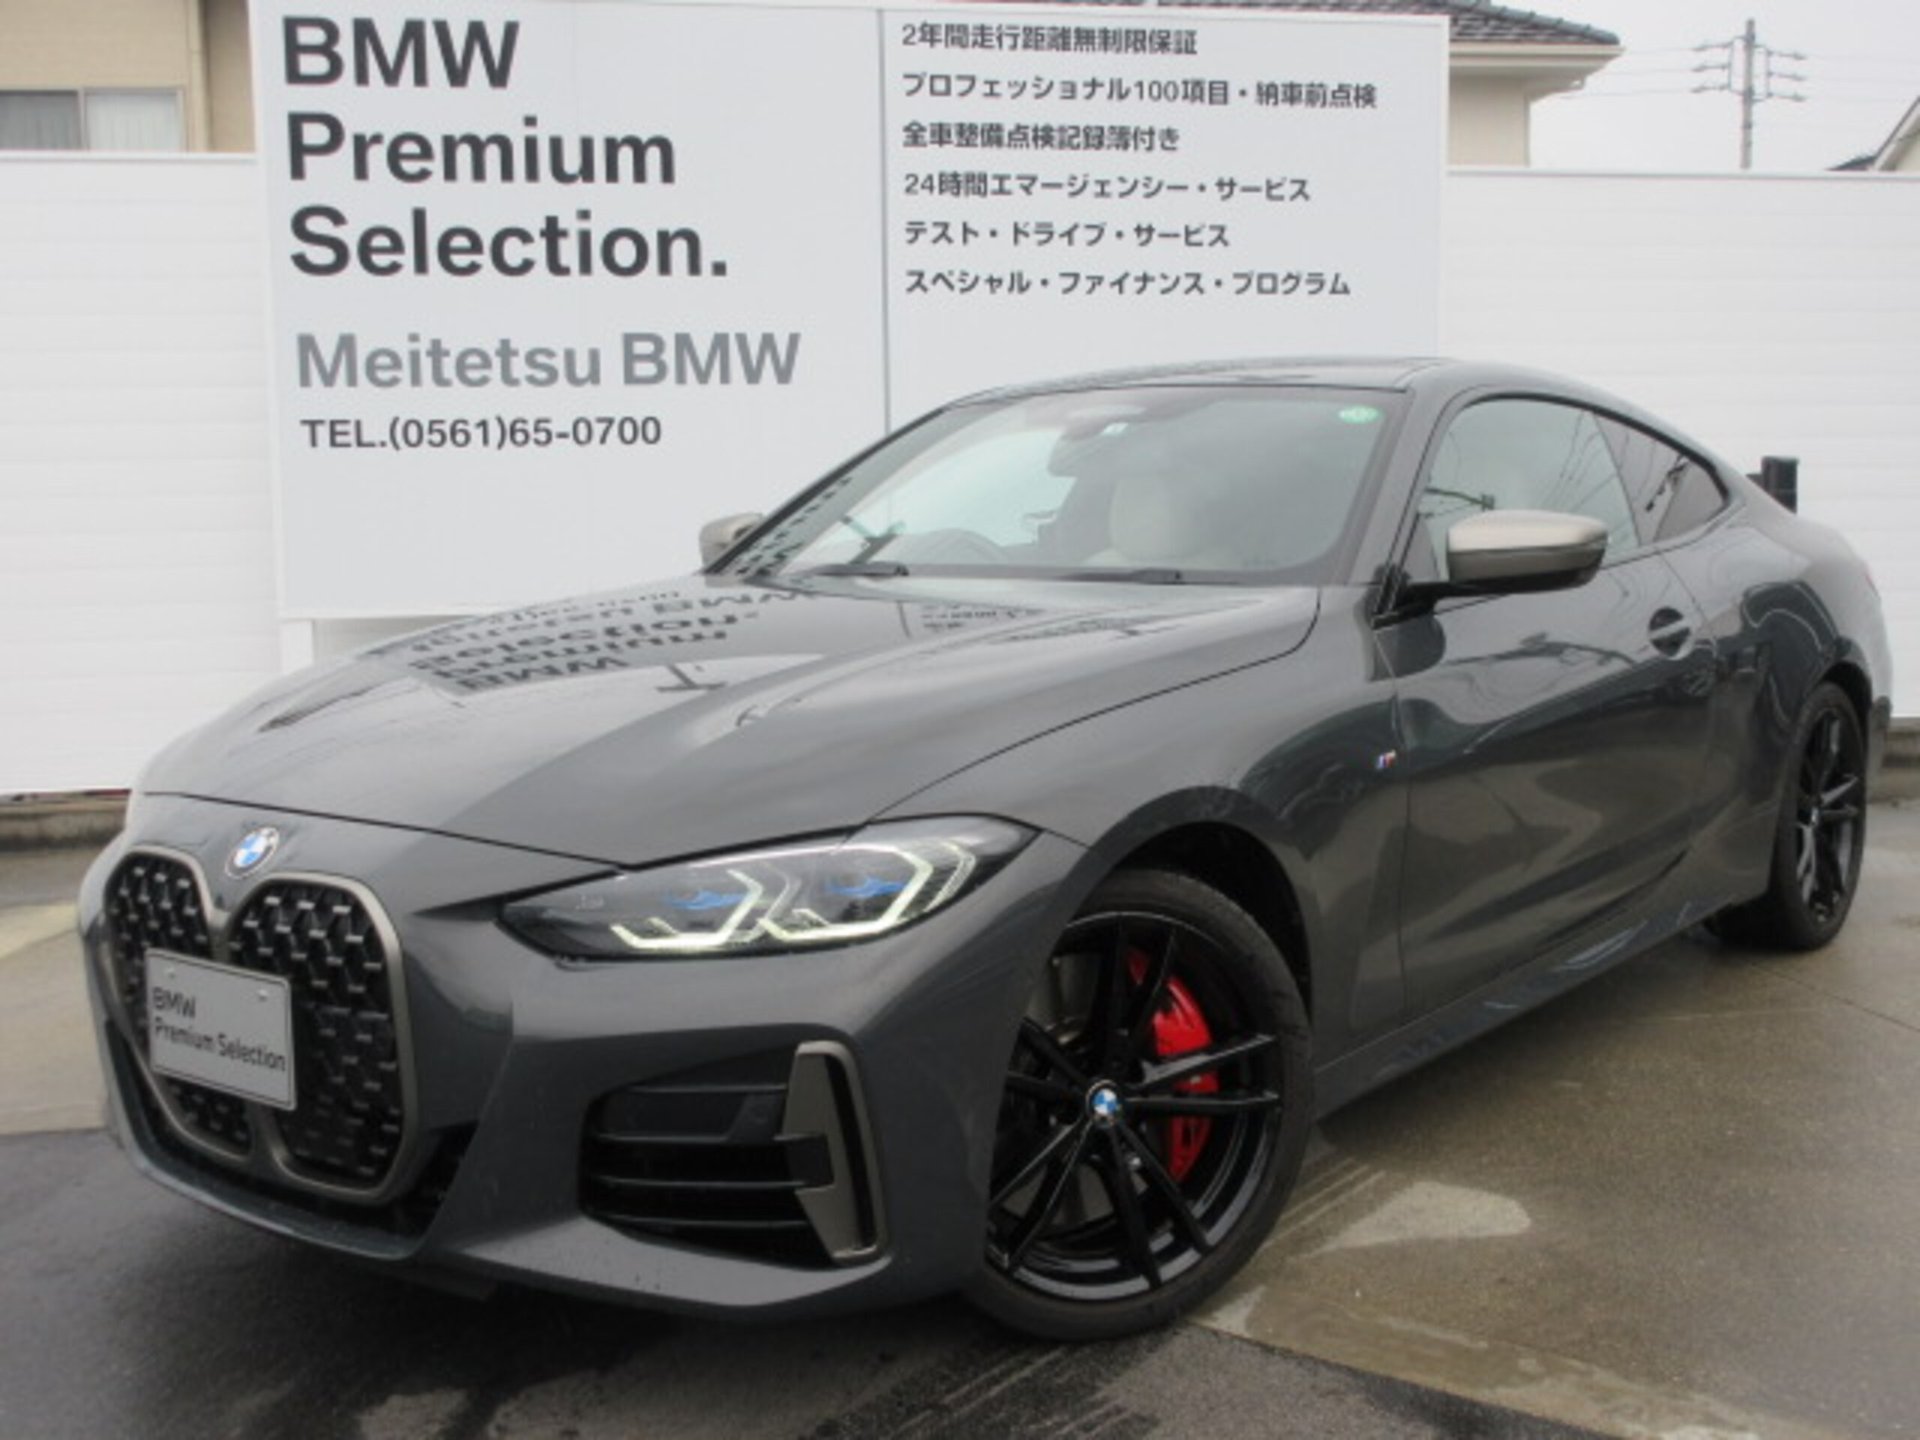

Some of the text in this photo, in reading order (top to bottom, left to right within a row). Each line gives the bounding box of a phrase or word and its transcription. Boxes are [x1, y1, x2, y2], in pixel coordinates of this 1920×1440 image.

[282, 16, 519, 89] BMW
[902, 22, 1198, 56] 2年間走行距離無制限保証
[902, 72, 1377, 109] プロフェッショナル100項目・納車前点検
[287, 111, 675, 185] Premium
[902, 121, 1180, 152] 全車整備点検記録簿付き
[904, 171, 1311, 202] 24時間エマージェンシー・サービス
[290, 204, 727, 277] Selection.
[904, 220, 1230, 248] テスト・ドライブ・サービス
[905, 269, 1351, 296] スペシャル・ファイナンス・プログラム
[298, 333, 801, 387] Meitetsu BMW
[300, 416, 662, 451] TEL.(0561)65-0700
[153, 986, 196, 1018] BMW
[155, 1016, 286, 1072] Premium Selection
